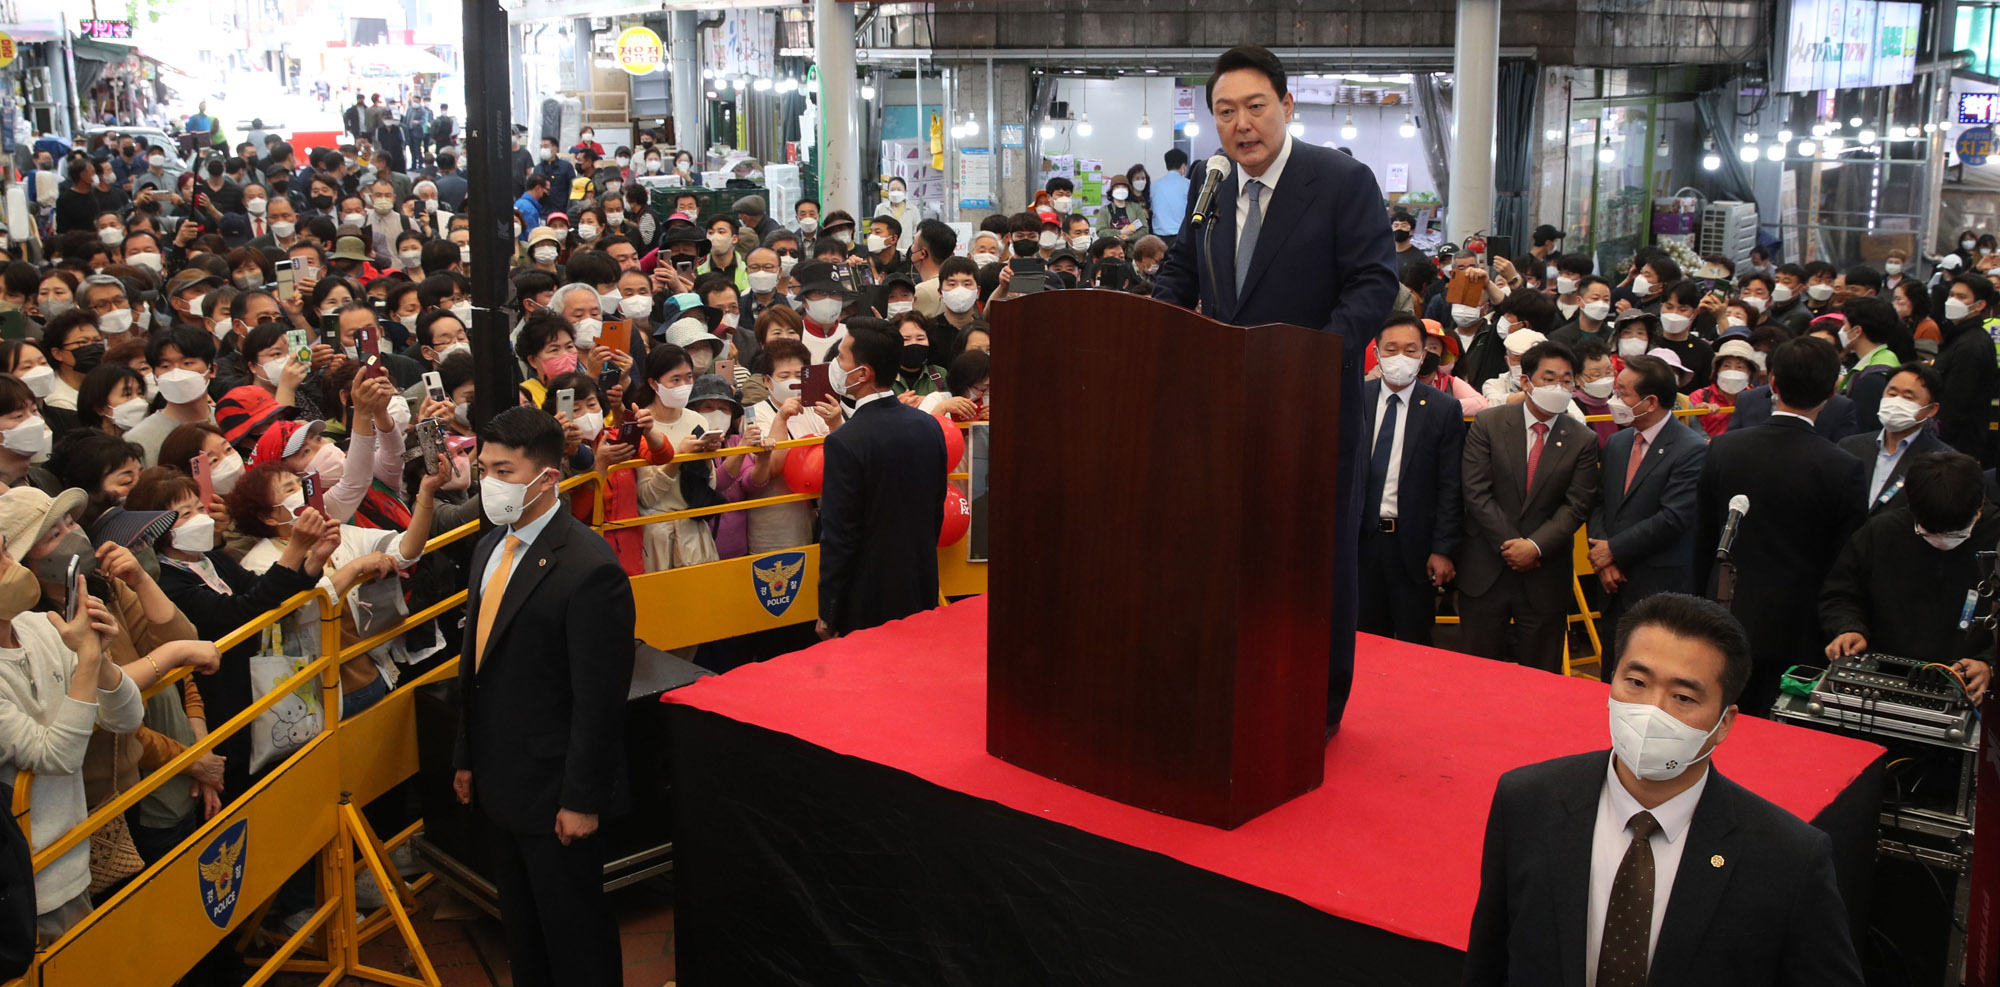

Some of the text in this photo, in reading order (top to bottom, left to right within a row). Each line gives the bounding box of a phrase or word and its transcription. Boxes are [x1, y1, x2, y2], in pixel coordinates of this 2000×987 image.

[0, 38, 13, 58] 물
[619, 46, 658, 63] 정육점
[766, 595, 790, 607] POLICE
[213, 891, 236, 918] POLICE
[1979, 888, 1990, 985] PYTHON
